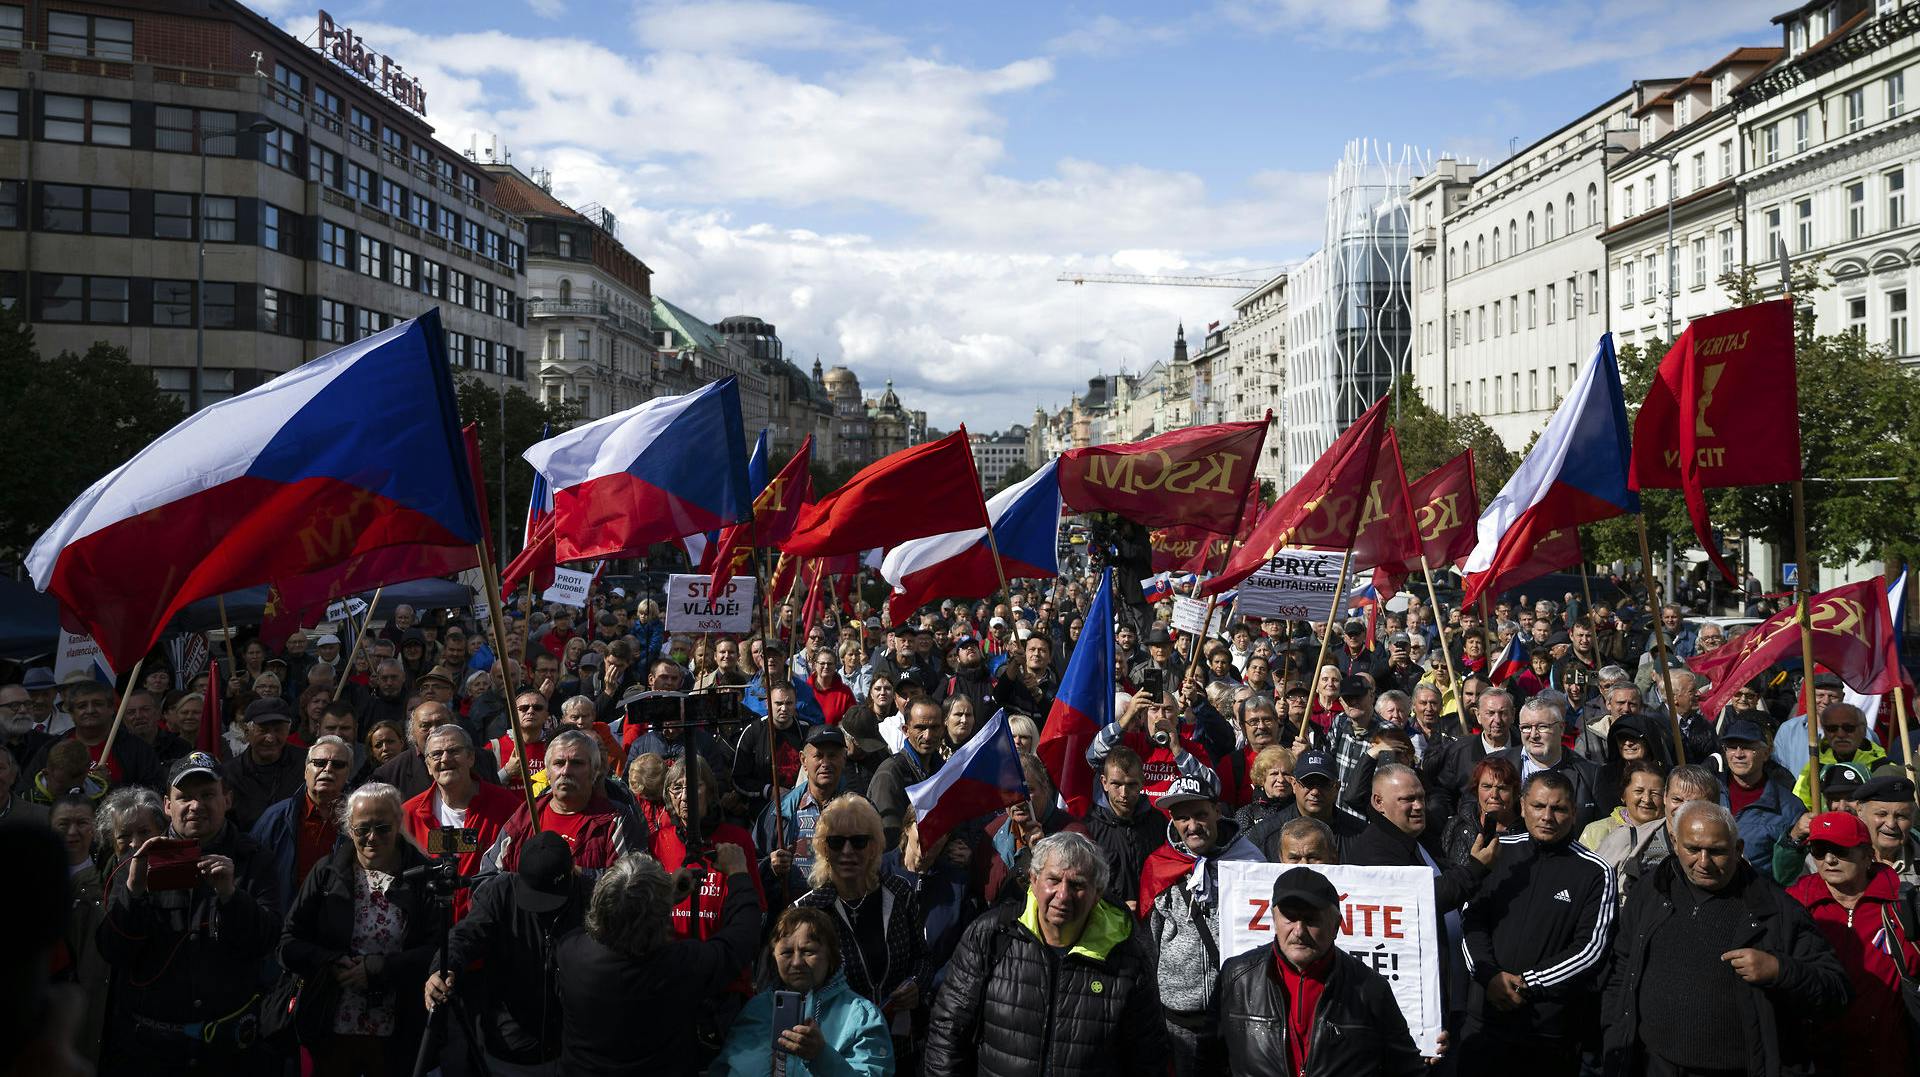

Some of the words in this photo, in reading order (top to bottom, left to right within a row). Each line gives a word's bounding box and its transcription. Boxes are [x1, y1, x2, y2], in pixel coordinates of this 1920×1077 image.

[319, 9, 376, 82] Palác
[381, 55, 427, 117] Fénix
[1694, 330, 1750, 357] VERITAS
[1270, 555, 1328, 577] PRYČ
[557, 574, 582, 585] PROTI
[553, 582, 585, 594] HUDOBĚ!
[688, 582, 737, 598] STP
[1308, 756, 1322, 764] CAT
